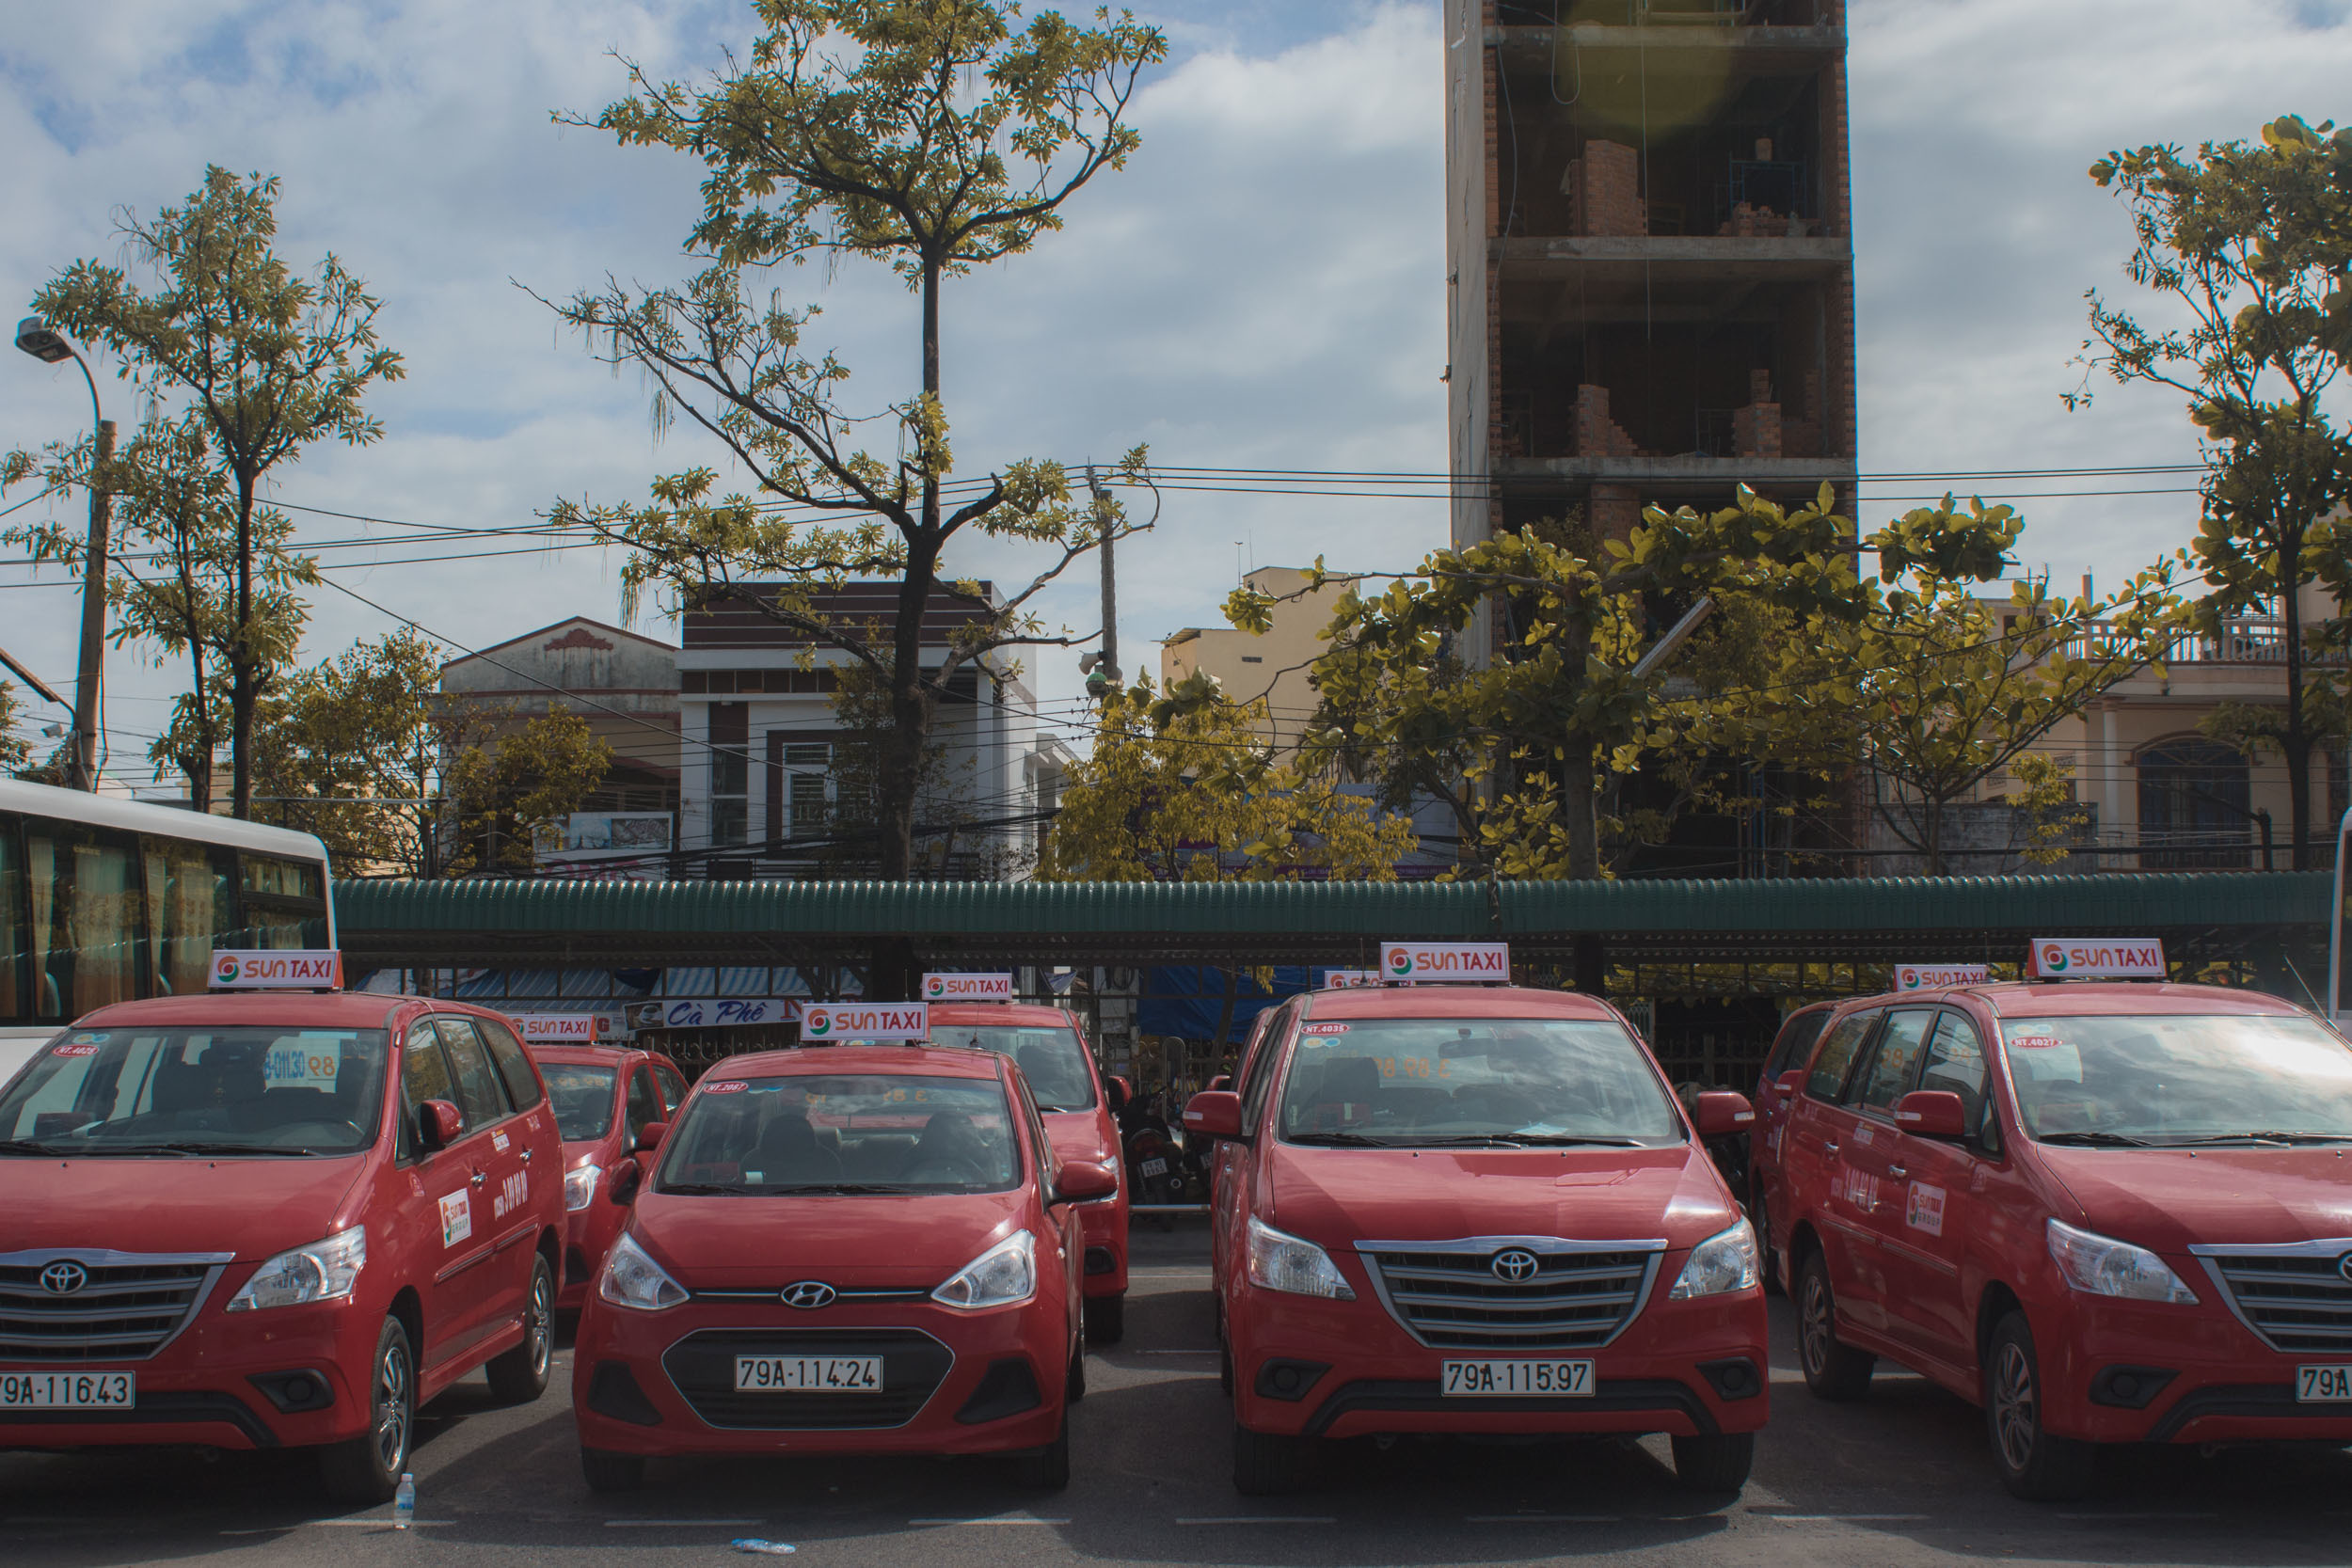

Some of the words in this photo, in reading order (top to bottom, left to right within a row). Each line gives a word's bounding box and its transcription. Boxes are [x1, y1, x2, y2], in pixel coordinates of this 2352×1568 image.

[1460, 952, 1502, 971] TAXI
[2115, 948, 2158, 967] TAXI
[290, 959, 332, 978] TAXI
[978, 979, 1009, 993] TAXI
[1953, 972, 1984, 986] TAXI
[667, 1002, 703, 1026] Cà
[715, 1000, 769, 1024] Phê
[881, 1011, 922, 1031] TAXI
[559, 1021, 588, 1034] TAXI
[740, 1359, 876, 1387] 79A-114.24
[1448, 1363, 1588, 1391] 79A-115.97
